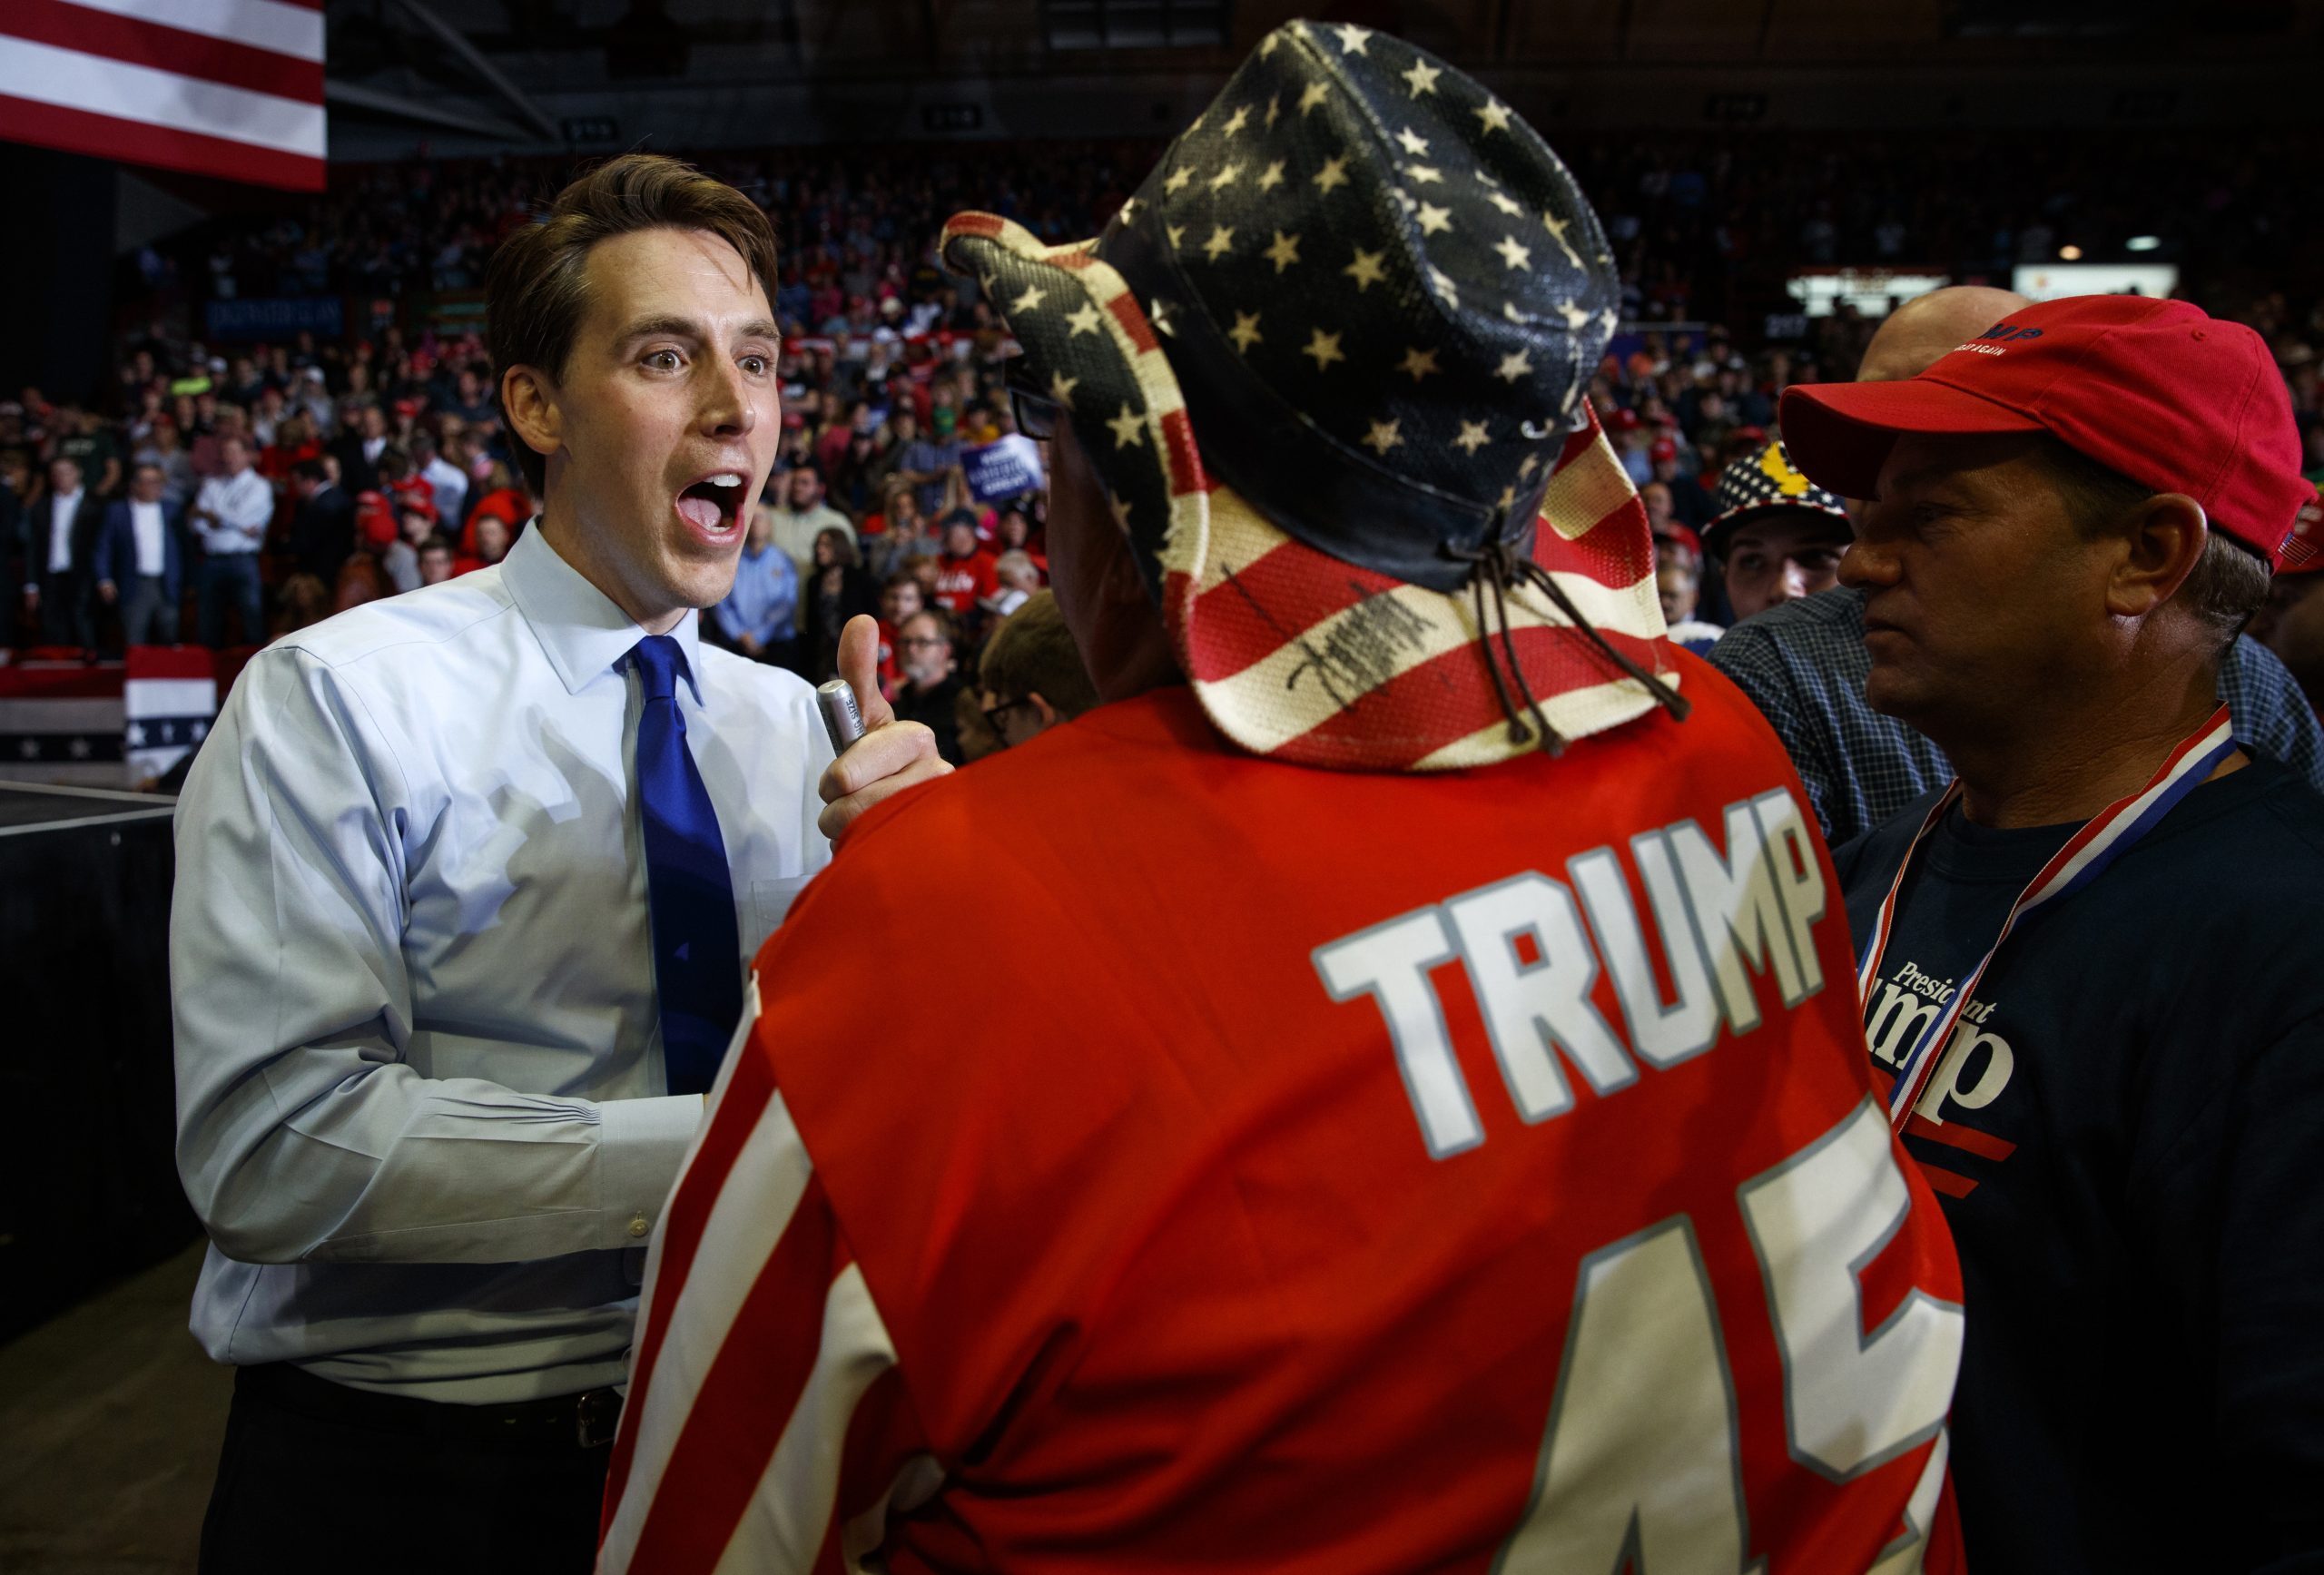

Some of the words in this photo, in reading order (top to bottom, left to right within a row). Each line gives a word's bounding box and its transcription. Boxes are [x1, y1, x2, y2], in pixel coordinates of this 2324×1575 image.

[1971, 344, 2006, 356] AGAIN
[1976, 323, 2043, 341] MP
[1310, 784, 1827, 1162] TRUMP
[1892, 960, 1997, 1025] Presint
[1865, 976, 2014, 1127] mp
[1487, 1089, 1966, 1575] 45
